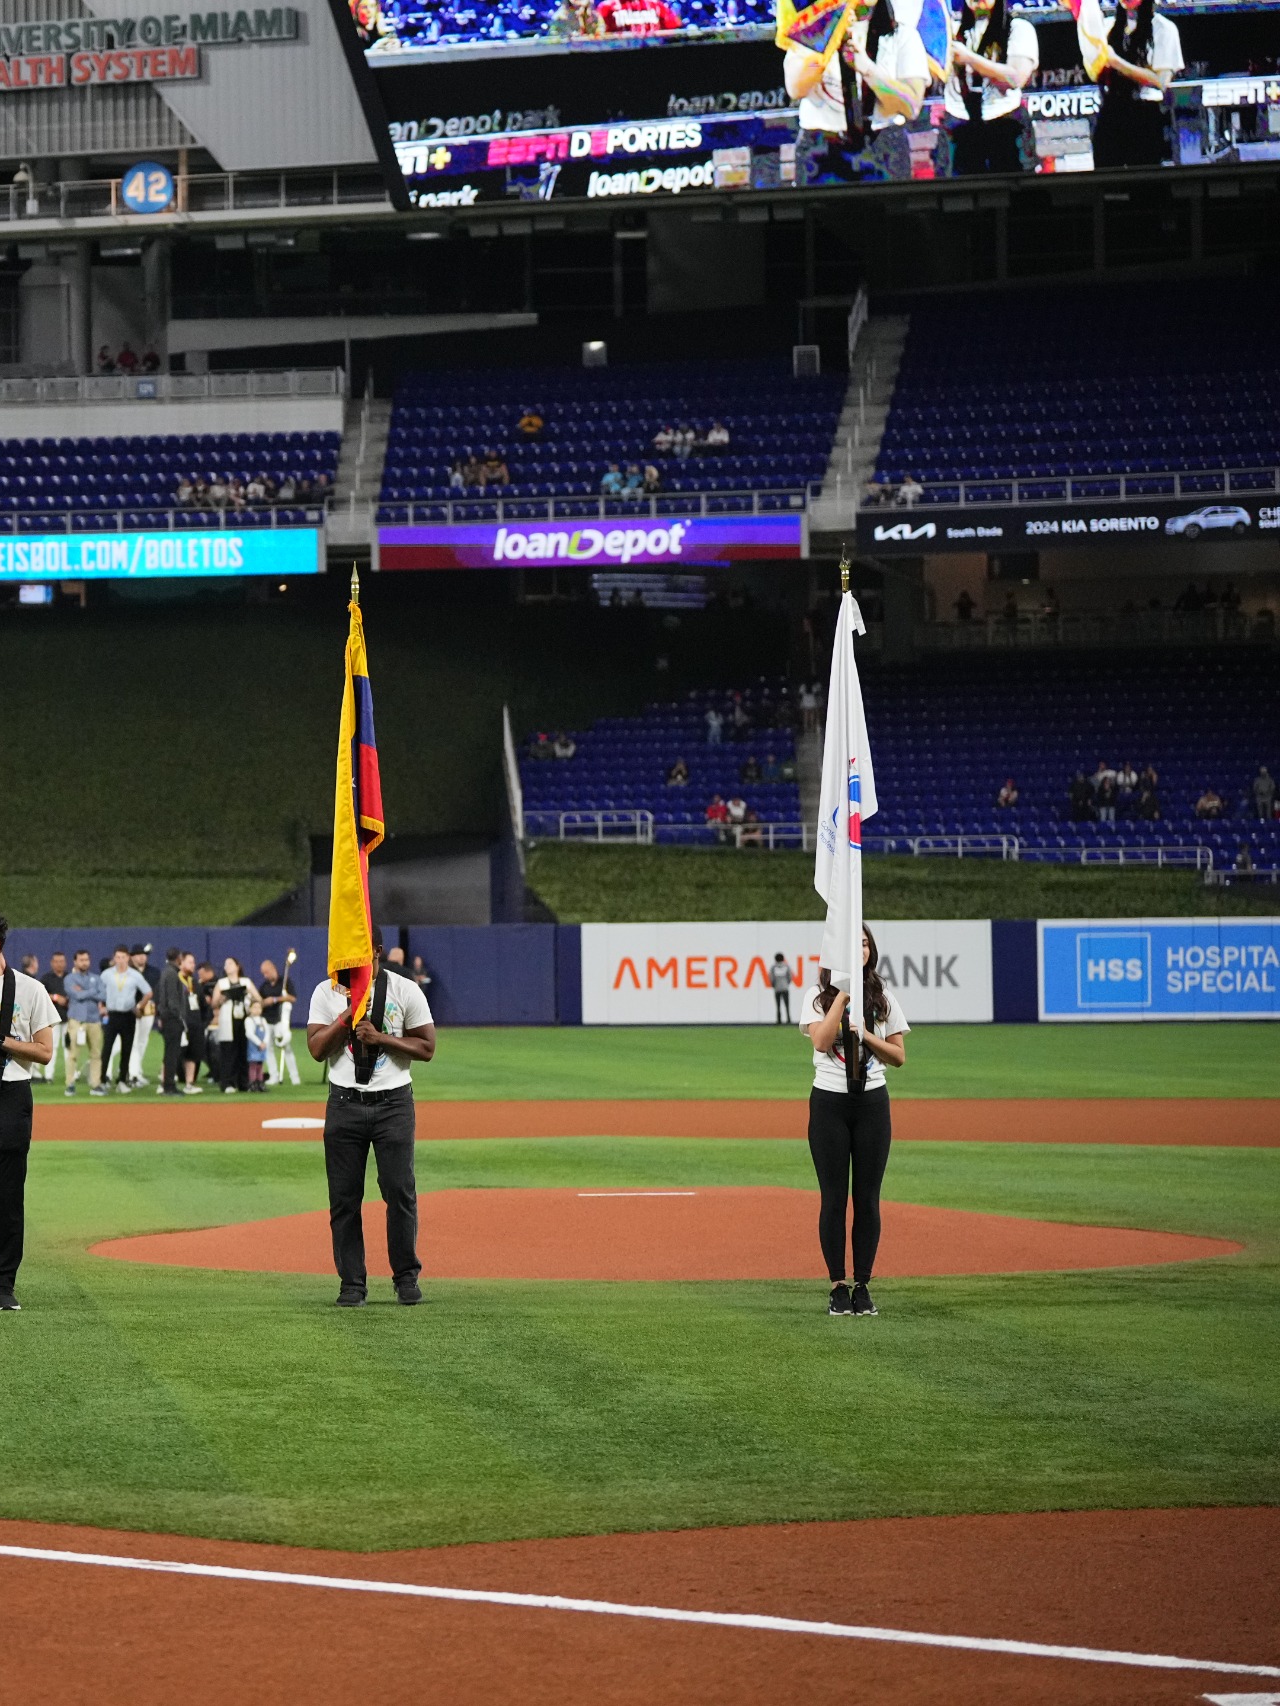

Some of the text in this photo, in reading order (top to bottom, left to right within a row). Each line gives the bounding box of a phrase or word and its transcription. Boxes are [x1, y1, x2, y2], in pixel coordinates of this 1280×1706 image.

[137, 14, 183, 46] OF
[188, 7, 299, 43] MIAMI
[70, 45, 198, 85] SYSTEM
[126, 171, 168, 203] 42
[586, 159, 714, 199] loanDepot
[493, 522, 686, 563] loanDepot
[874, 522, 937, 541] KIA
[1025, 521, 1060, 535] 2024
[1061, 519, 1087, 533] KIA
[1089, 516, 1160, 532] SORENTO
[1087, 958, 1143, 982] HSS
[1167, 970, 1276, 994] SPECIAL
